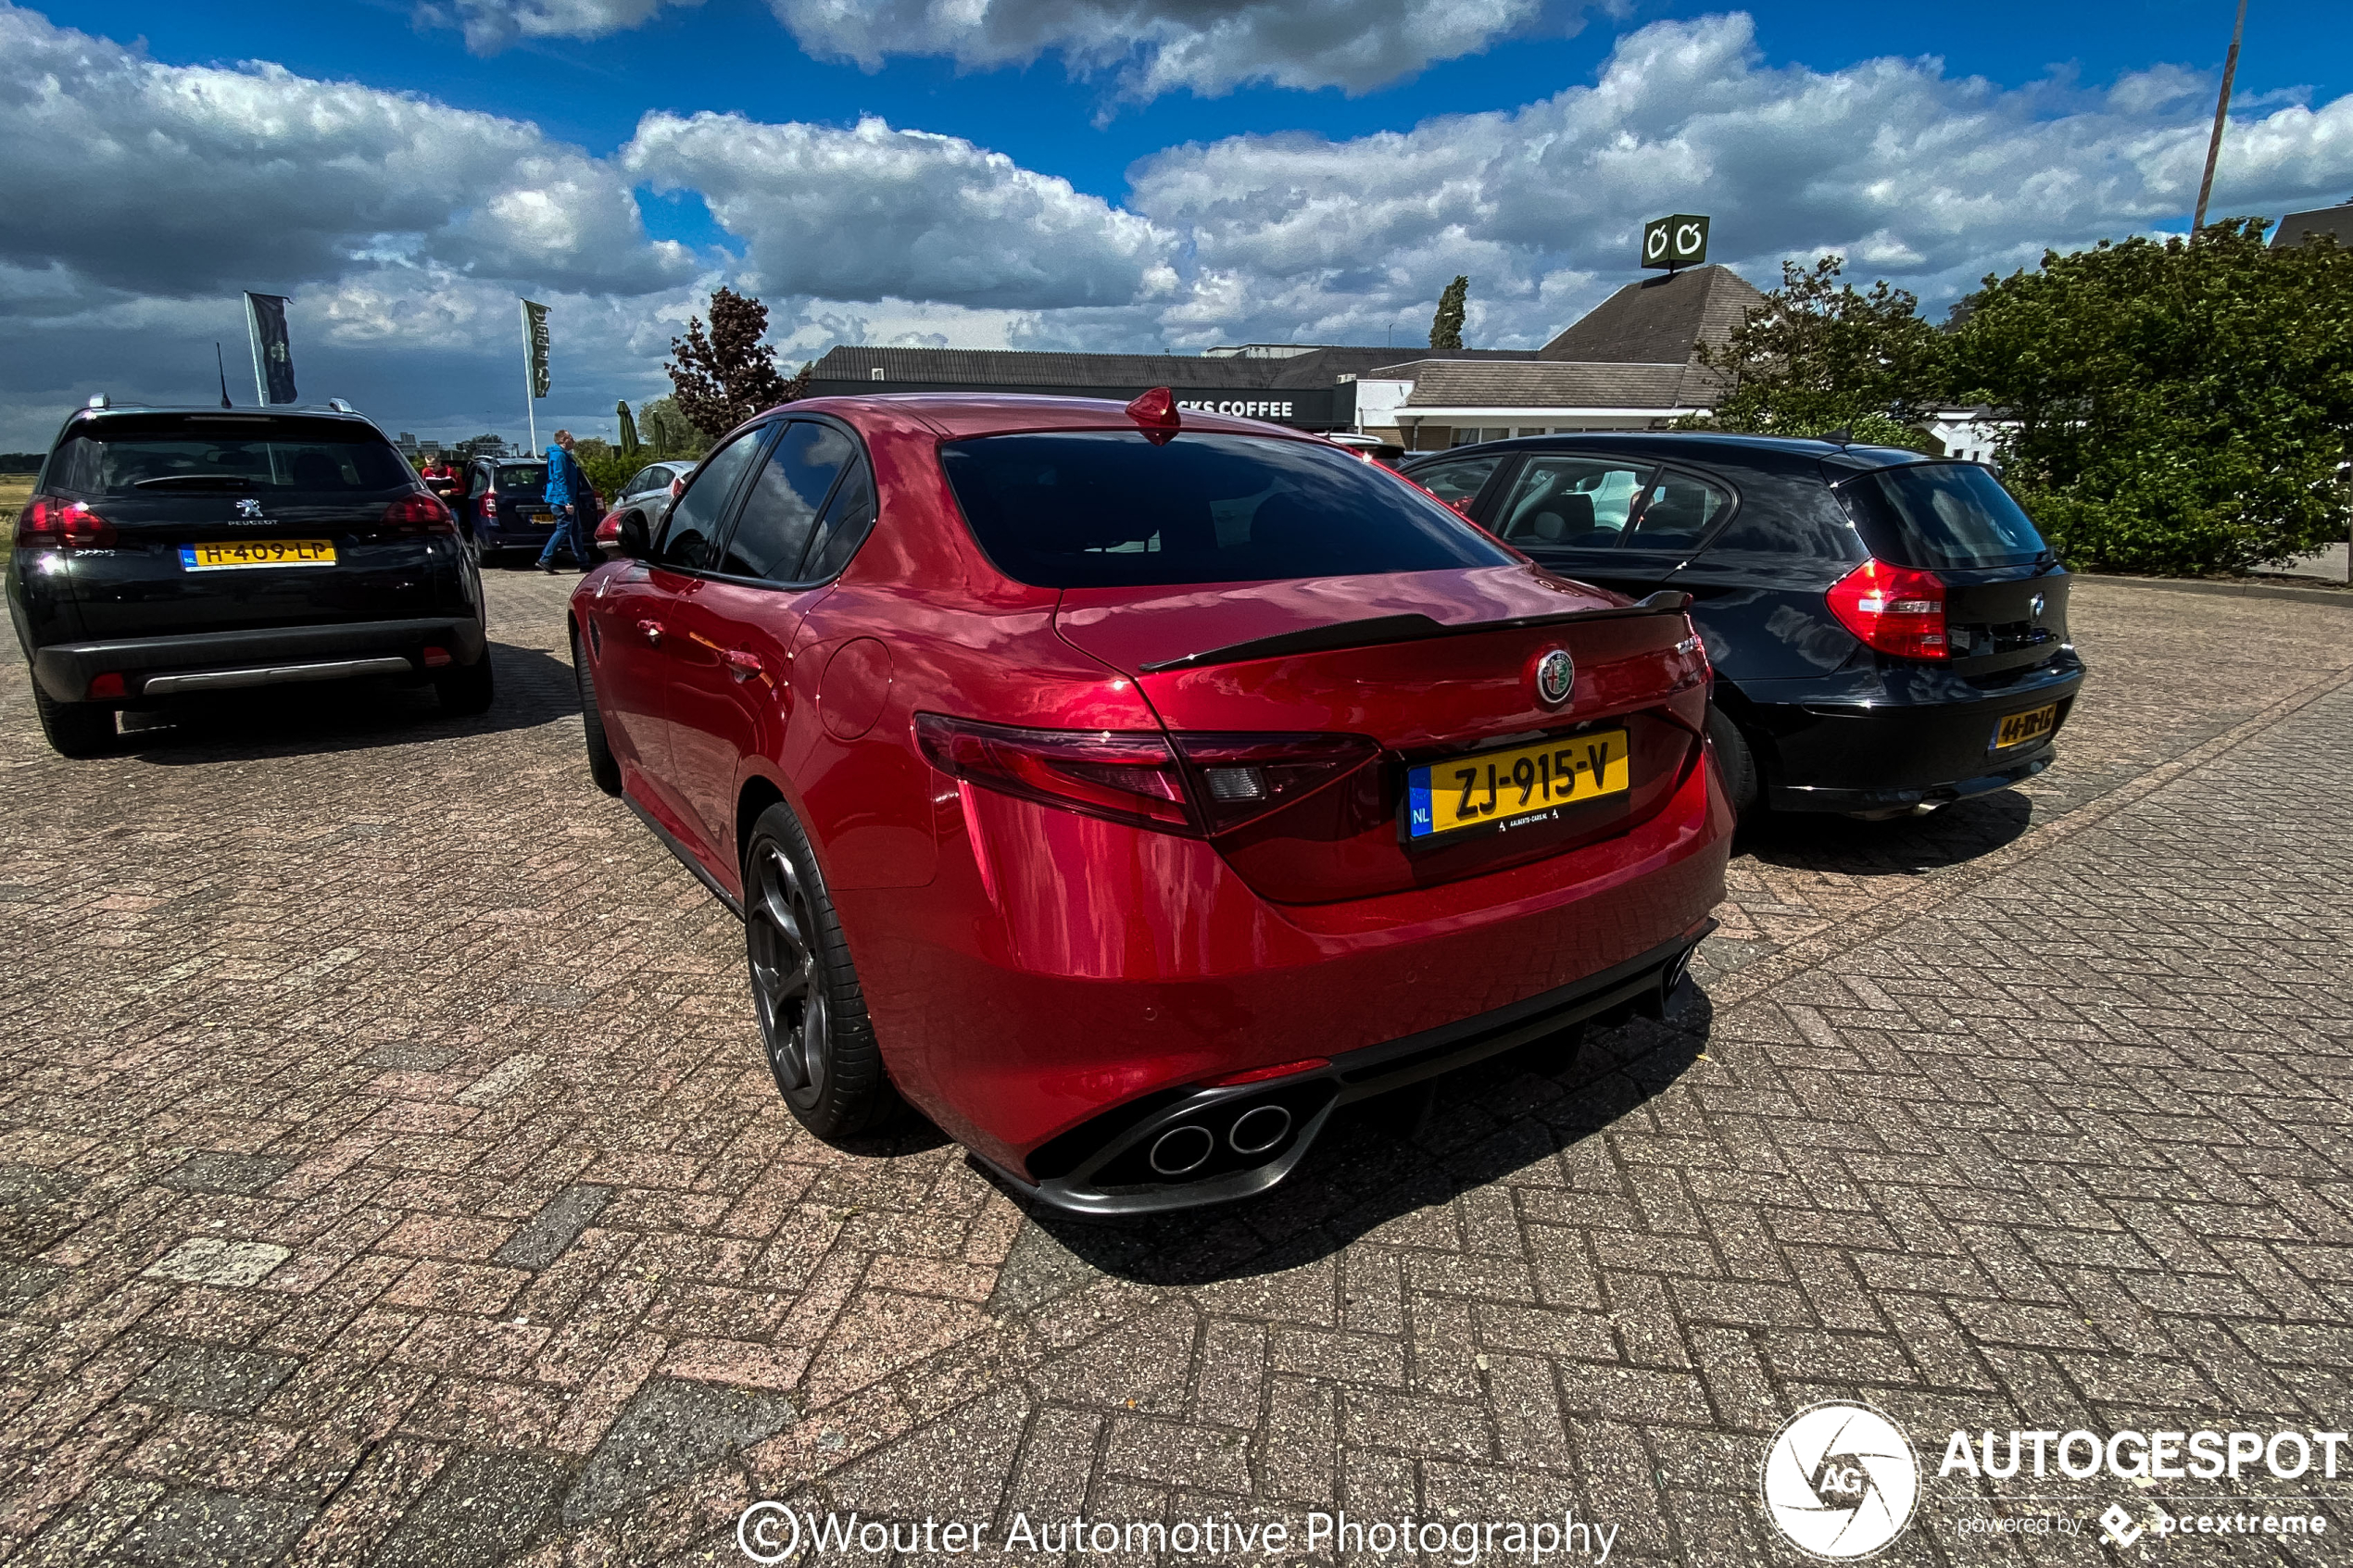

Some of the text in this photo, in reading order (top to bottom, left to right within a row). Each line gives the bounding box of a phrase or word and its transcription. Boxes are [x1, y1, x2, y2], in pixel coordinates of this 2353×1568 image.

[1218, 400, 1293, 417] COFFEE
[204, 542, 326, 563] H-409-LP
[1413, 741, 1608, 824] NL ZJ-915-V
